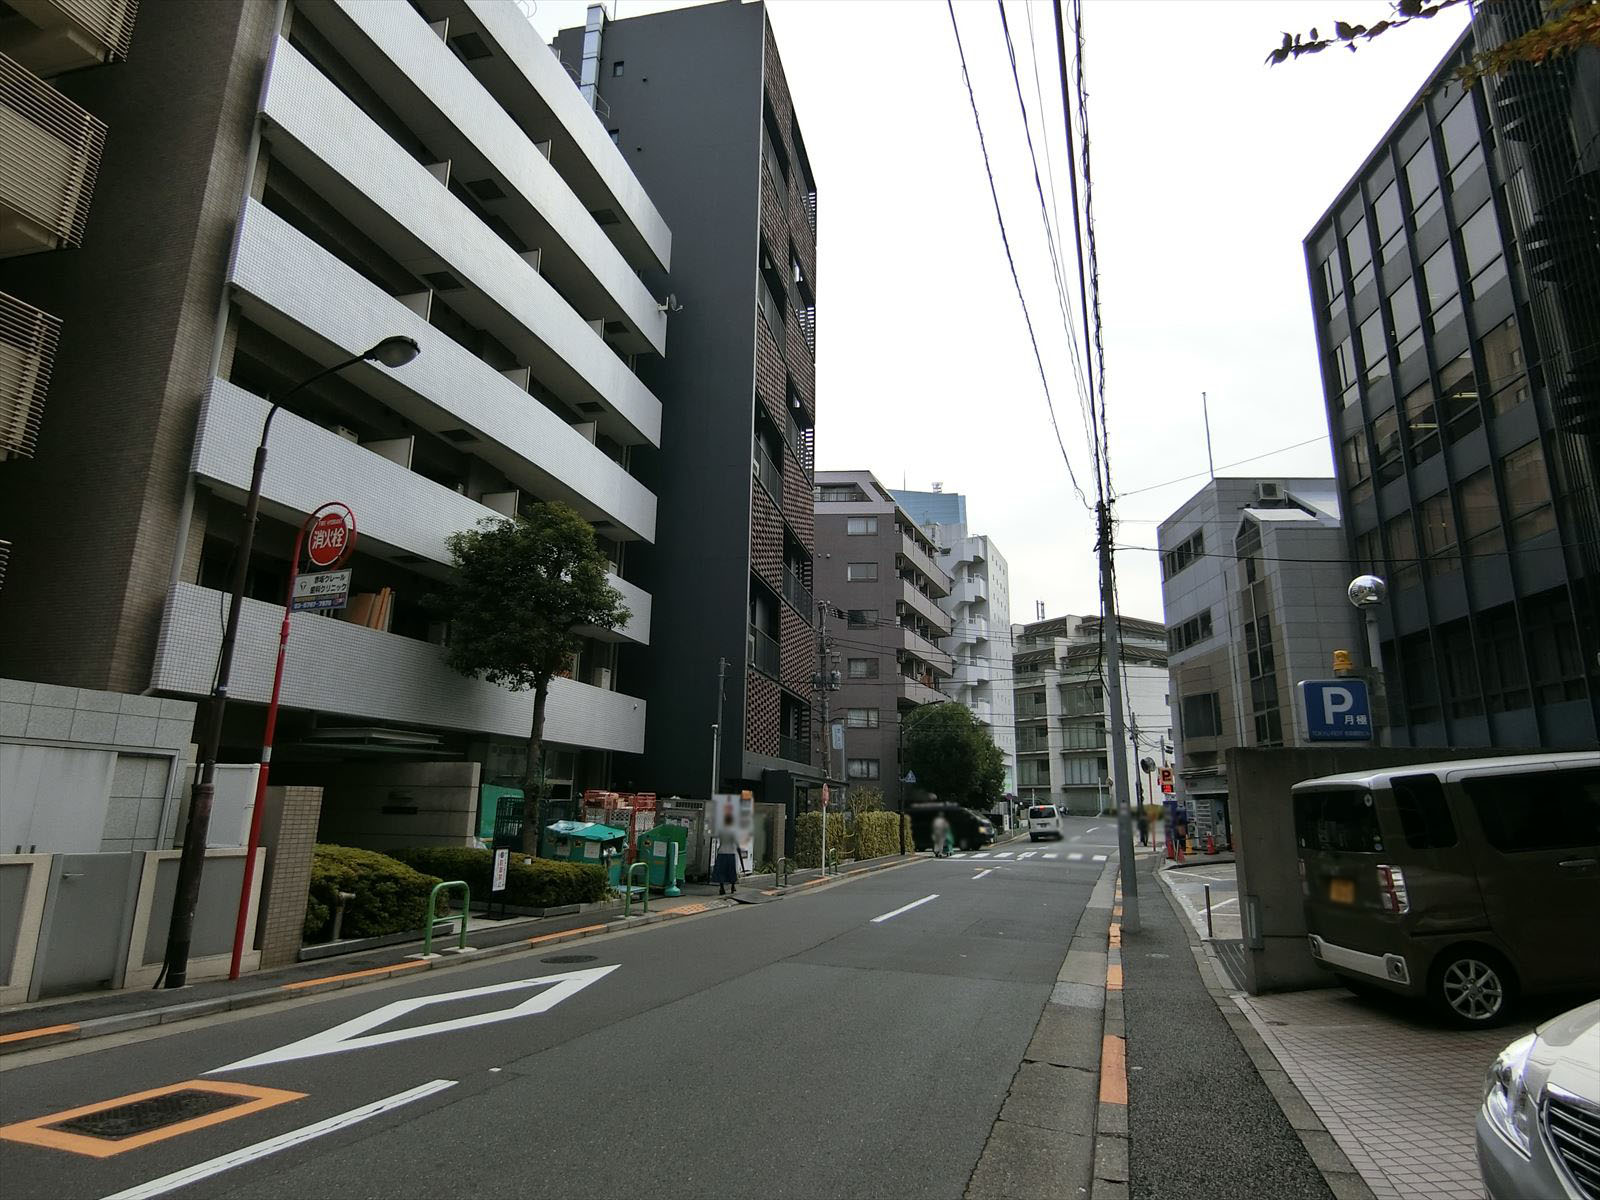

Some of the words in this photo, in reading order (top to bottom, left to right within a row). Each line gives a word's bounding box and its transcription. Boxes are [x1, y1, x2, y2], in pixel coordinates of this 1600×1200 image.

[312, 527, 344, 550] 消火栓
[1322, 686, 1353, 725] P
[1344, 714, 1368, 725] 月極
[1162, 770, 1171, 781] P
